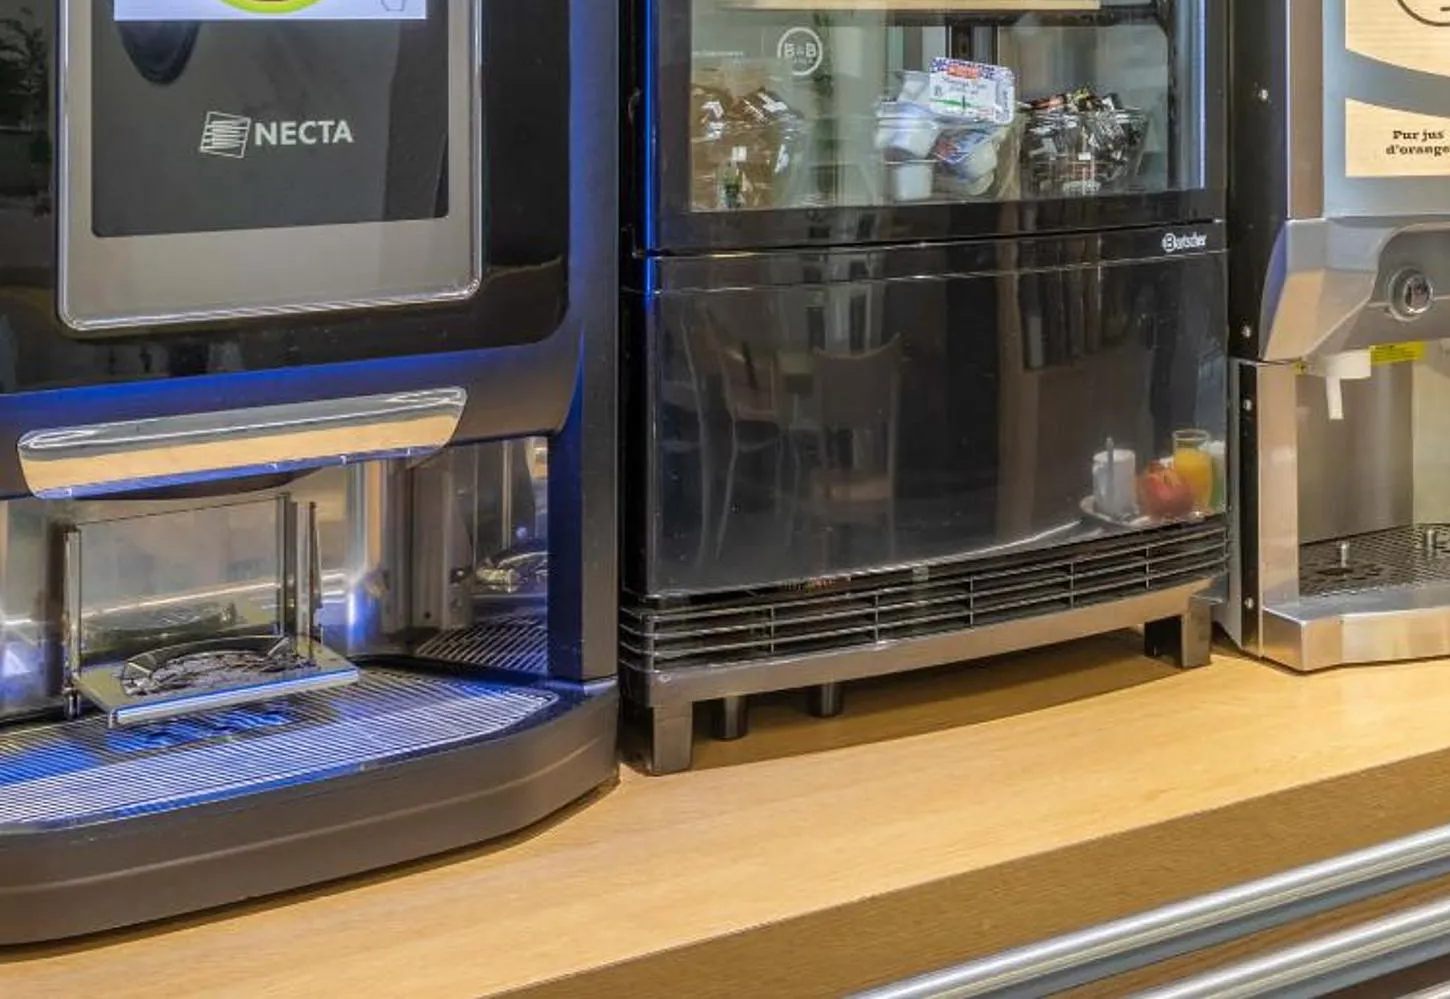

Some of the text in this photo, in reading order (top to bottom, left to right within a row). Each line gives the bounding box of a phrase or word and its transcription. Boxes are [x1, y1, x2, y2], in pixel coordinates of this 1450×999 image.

[254, 120, 354, 147] NECTA
[1392, 128, 1445, 142] Pur jus
